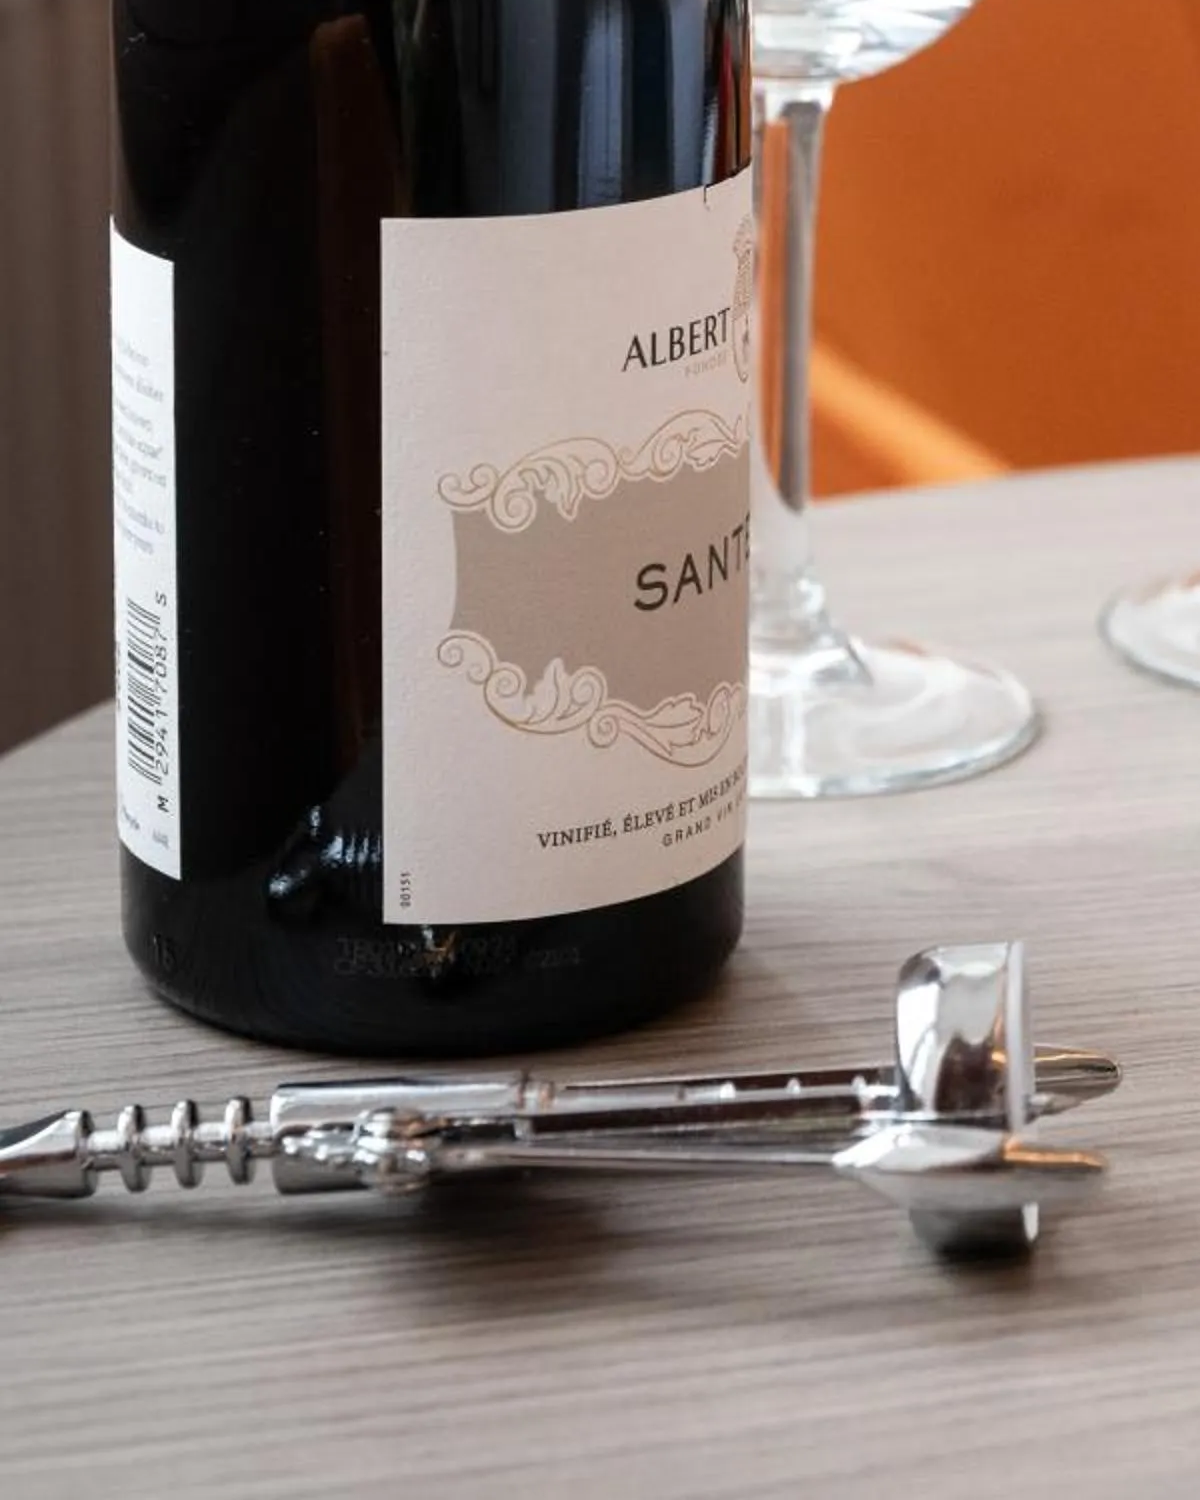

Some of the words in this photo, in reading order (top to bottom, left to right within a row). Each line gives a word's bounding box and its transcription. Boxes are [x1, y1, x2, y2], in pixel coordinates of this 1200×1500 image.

[621, 306, 731, 373] ALBERT
[536, 817, 617, 848] VINIFIÉ,
[623, 802, 675, 834] ÉLEVÉ
[679, 797, 696, 817] ET
